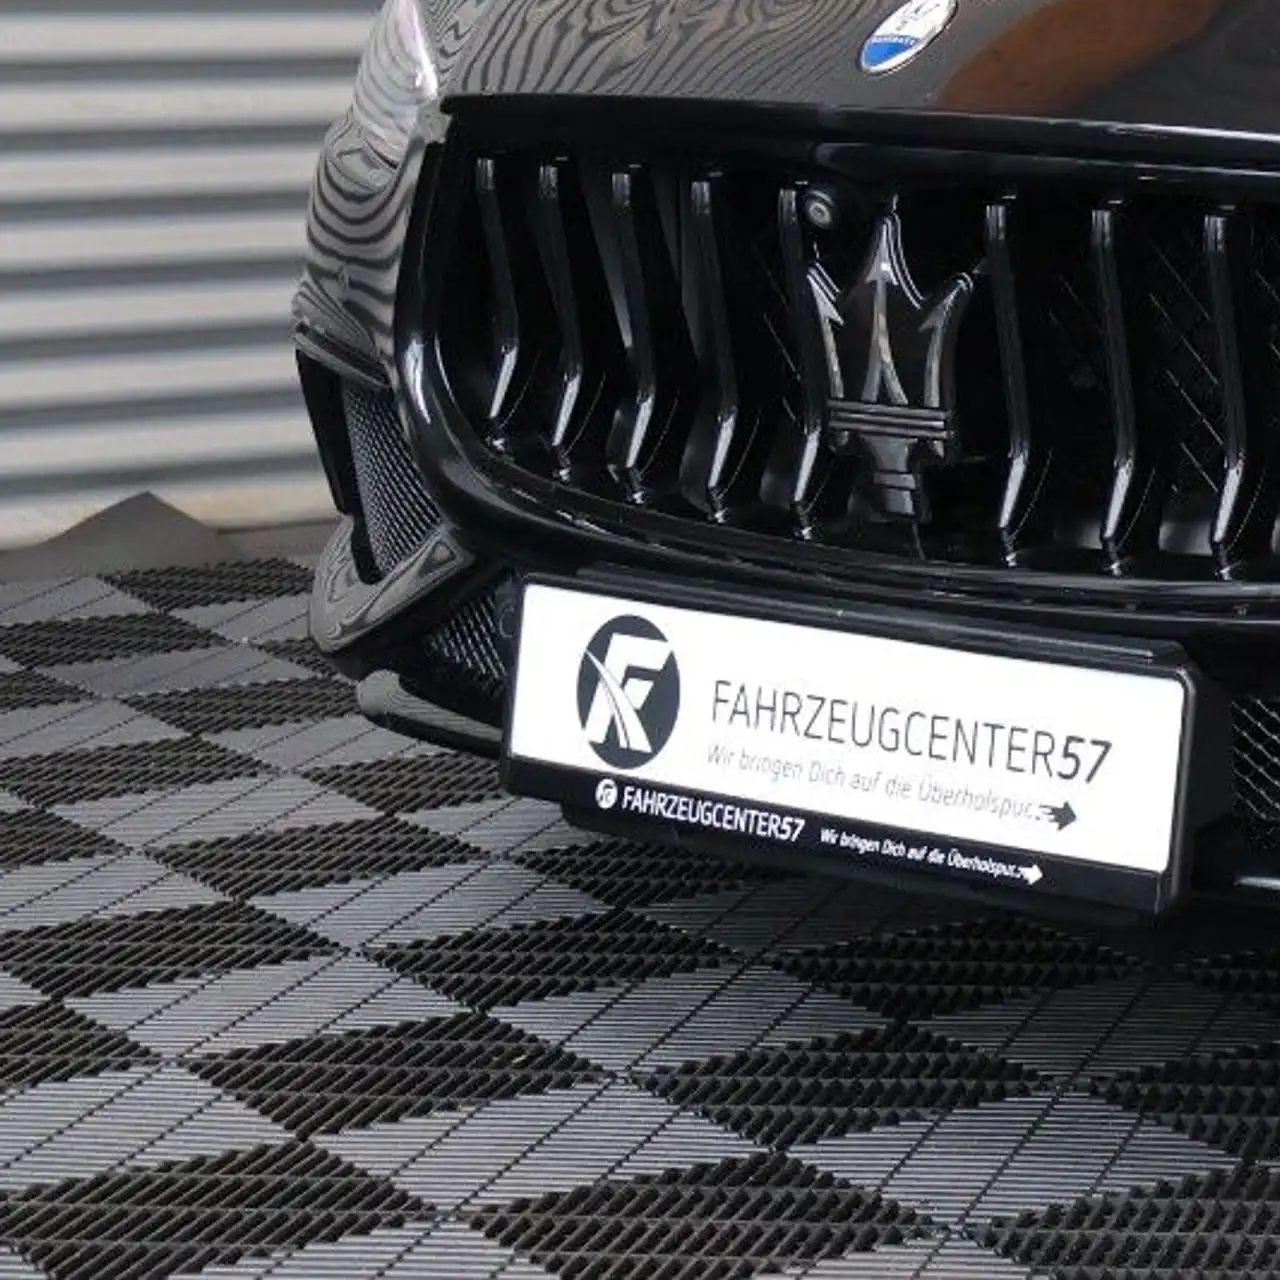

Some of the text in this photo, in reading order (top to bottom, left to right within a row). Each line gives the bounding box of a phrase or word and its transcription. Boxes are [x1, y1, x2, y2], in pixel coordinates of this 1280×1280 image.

[711, 679, 1113, 785] FAHRZEUGCENTER57
[707, 743, 736, 766] Wir
[739, 750, 803, 782] bringen
[808, 760, 846, 787] Dich
[849, 771, 883, 793] auf
[885, 774, 913, 800] die
[621, 785, 806, 841] FAHRZEUGCENTER57
[820, 826, 838, 845] Wir
[840, 833, 880, 855] bringen
[881, 837, 905, 857] Dich
[906, 845, 929, 862] auf
[928, 847, 947, 865] die
